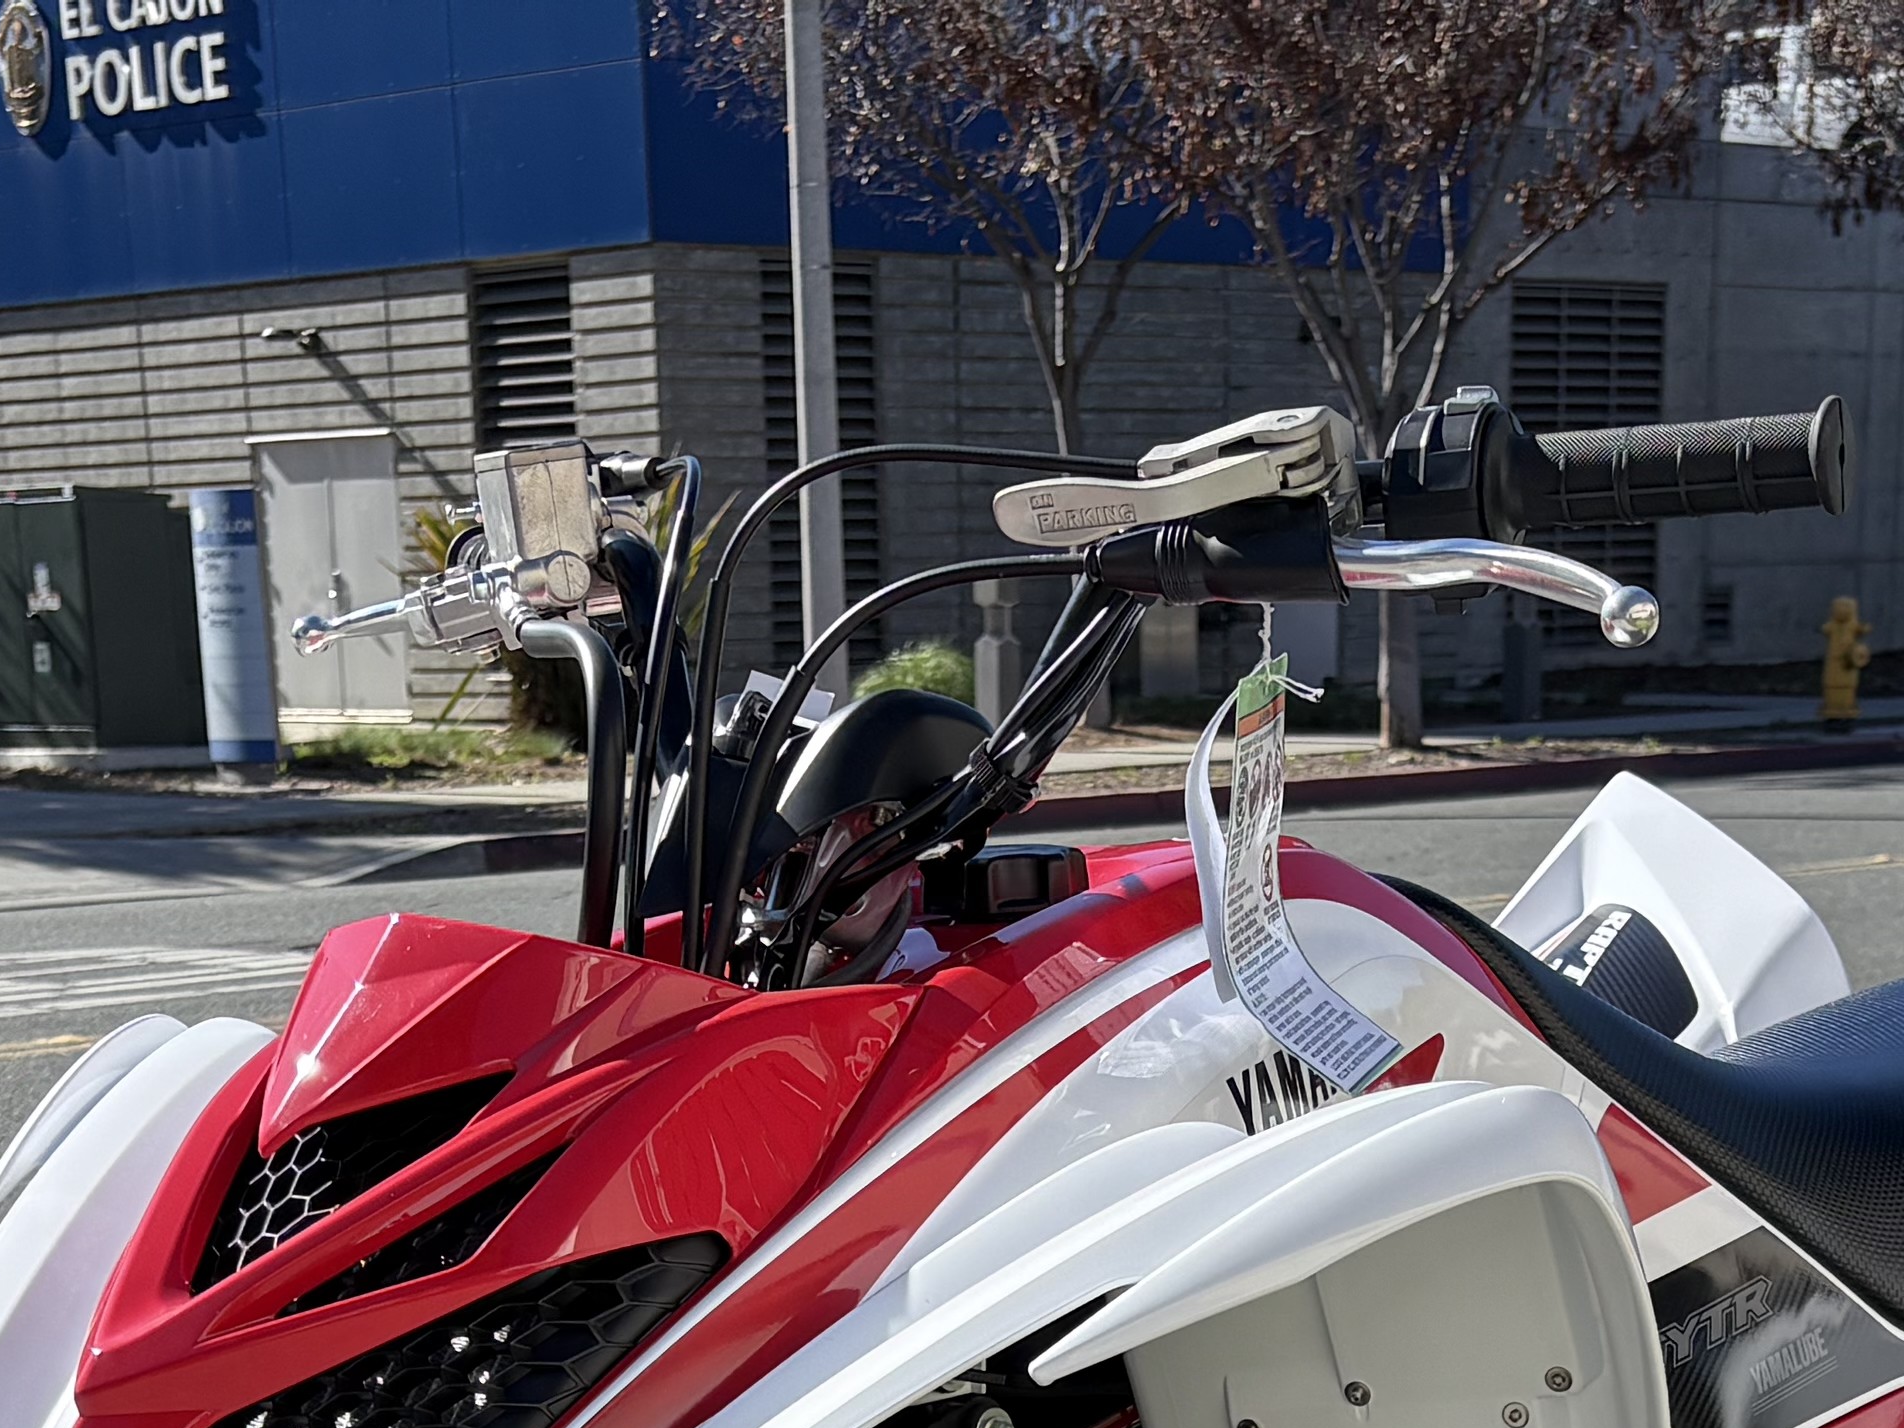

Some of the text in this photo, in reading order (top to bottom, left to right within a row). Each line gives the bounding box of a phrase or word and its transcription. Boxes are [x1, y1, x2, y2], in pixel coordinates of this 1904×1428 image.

[59, 0, 103, 40] EL
[65, 32, 229, 120] POLICE
[1037, 503, 1137, 534] PARKING
[1562, 910, 1632, 987] RAPT
[1226, 1049, 1337, 1136] YAMA
[1659, 1274, 1775, 1368] YTR
[1749, 1327, 1829, 1394] YAMALUBE
